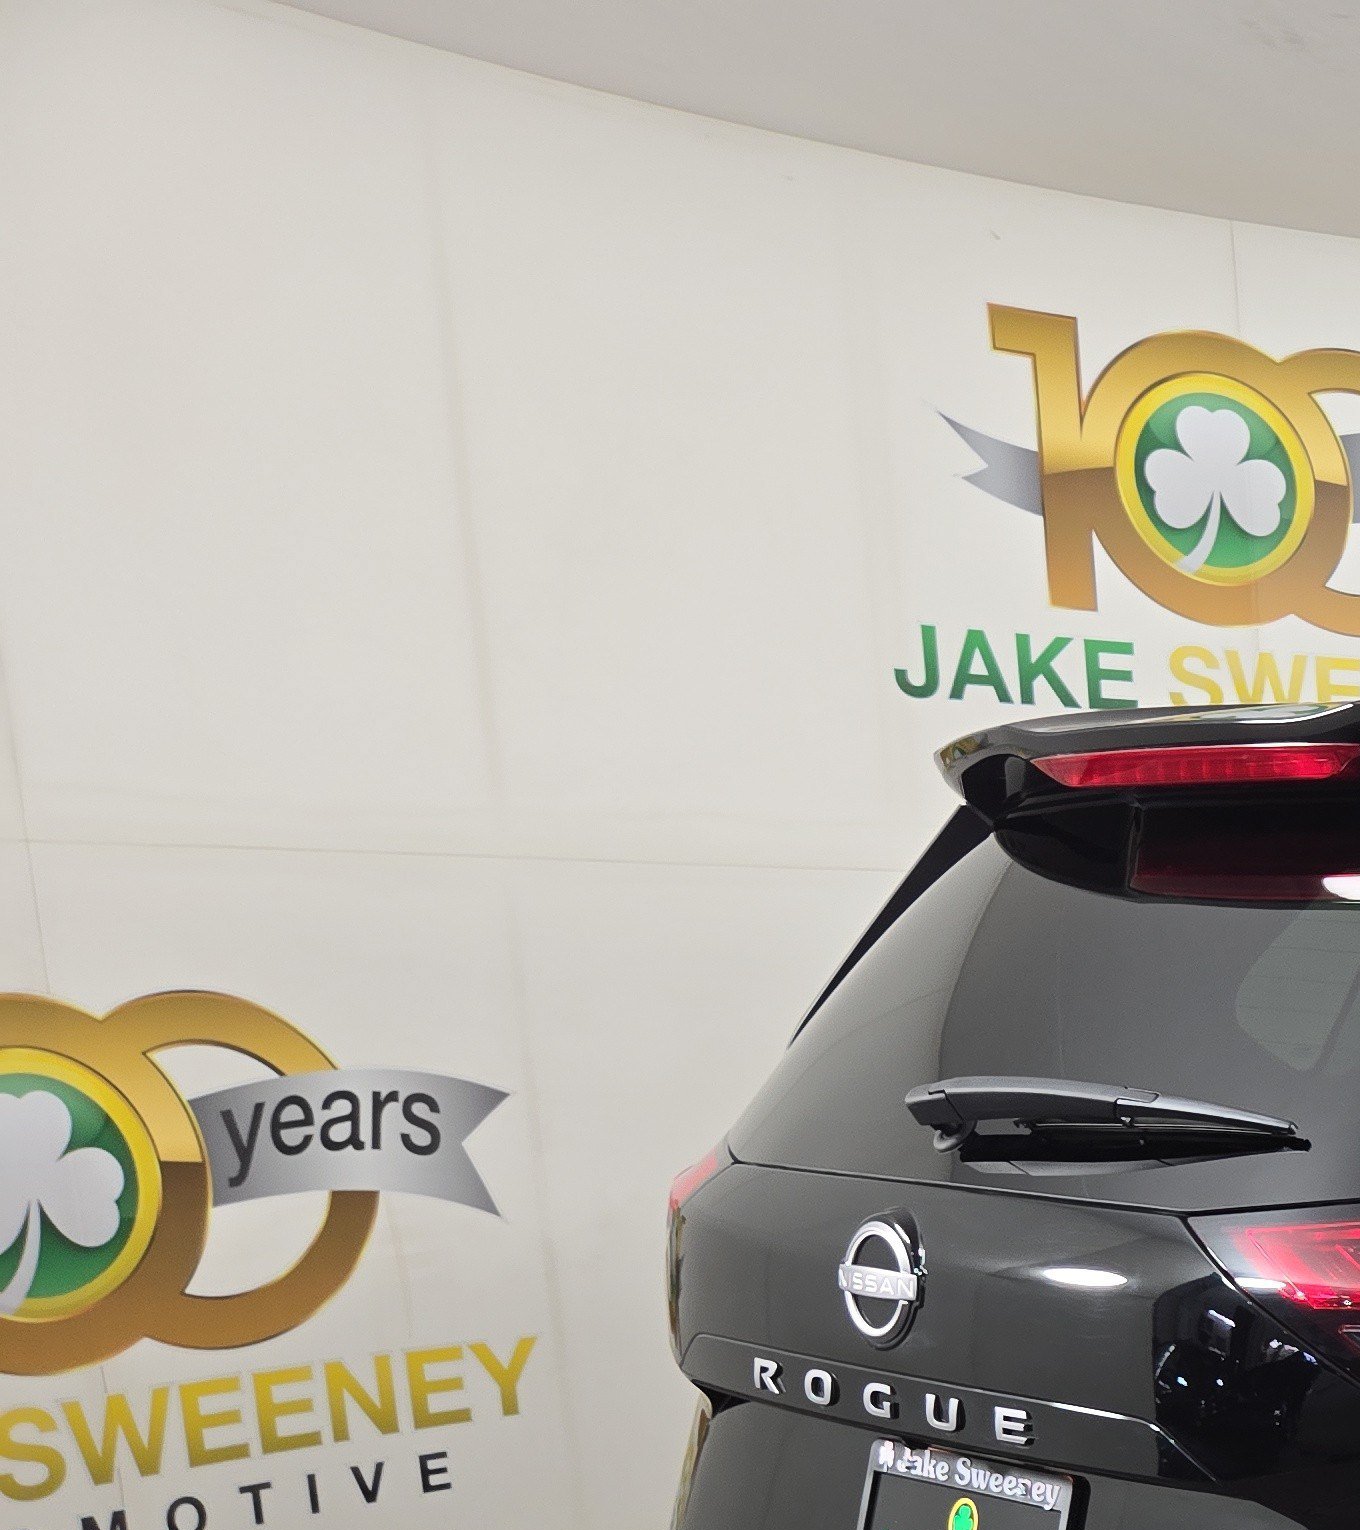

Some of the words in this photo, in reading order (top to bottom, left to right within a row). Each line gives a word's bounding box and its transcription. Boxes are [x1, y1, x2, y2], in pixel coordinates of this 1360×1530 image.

[893, 624, 1139, 709] JAKE
[219, 1089, 442, 1188] years
[0, 1336, 538, 1503] SWEENEY
[753, 1357, 1034, 1444] ROGUE
[897, 1447, 949, 1481] Jake
[955, 1457, 1060, 1510] Sweeney
